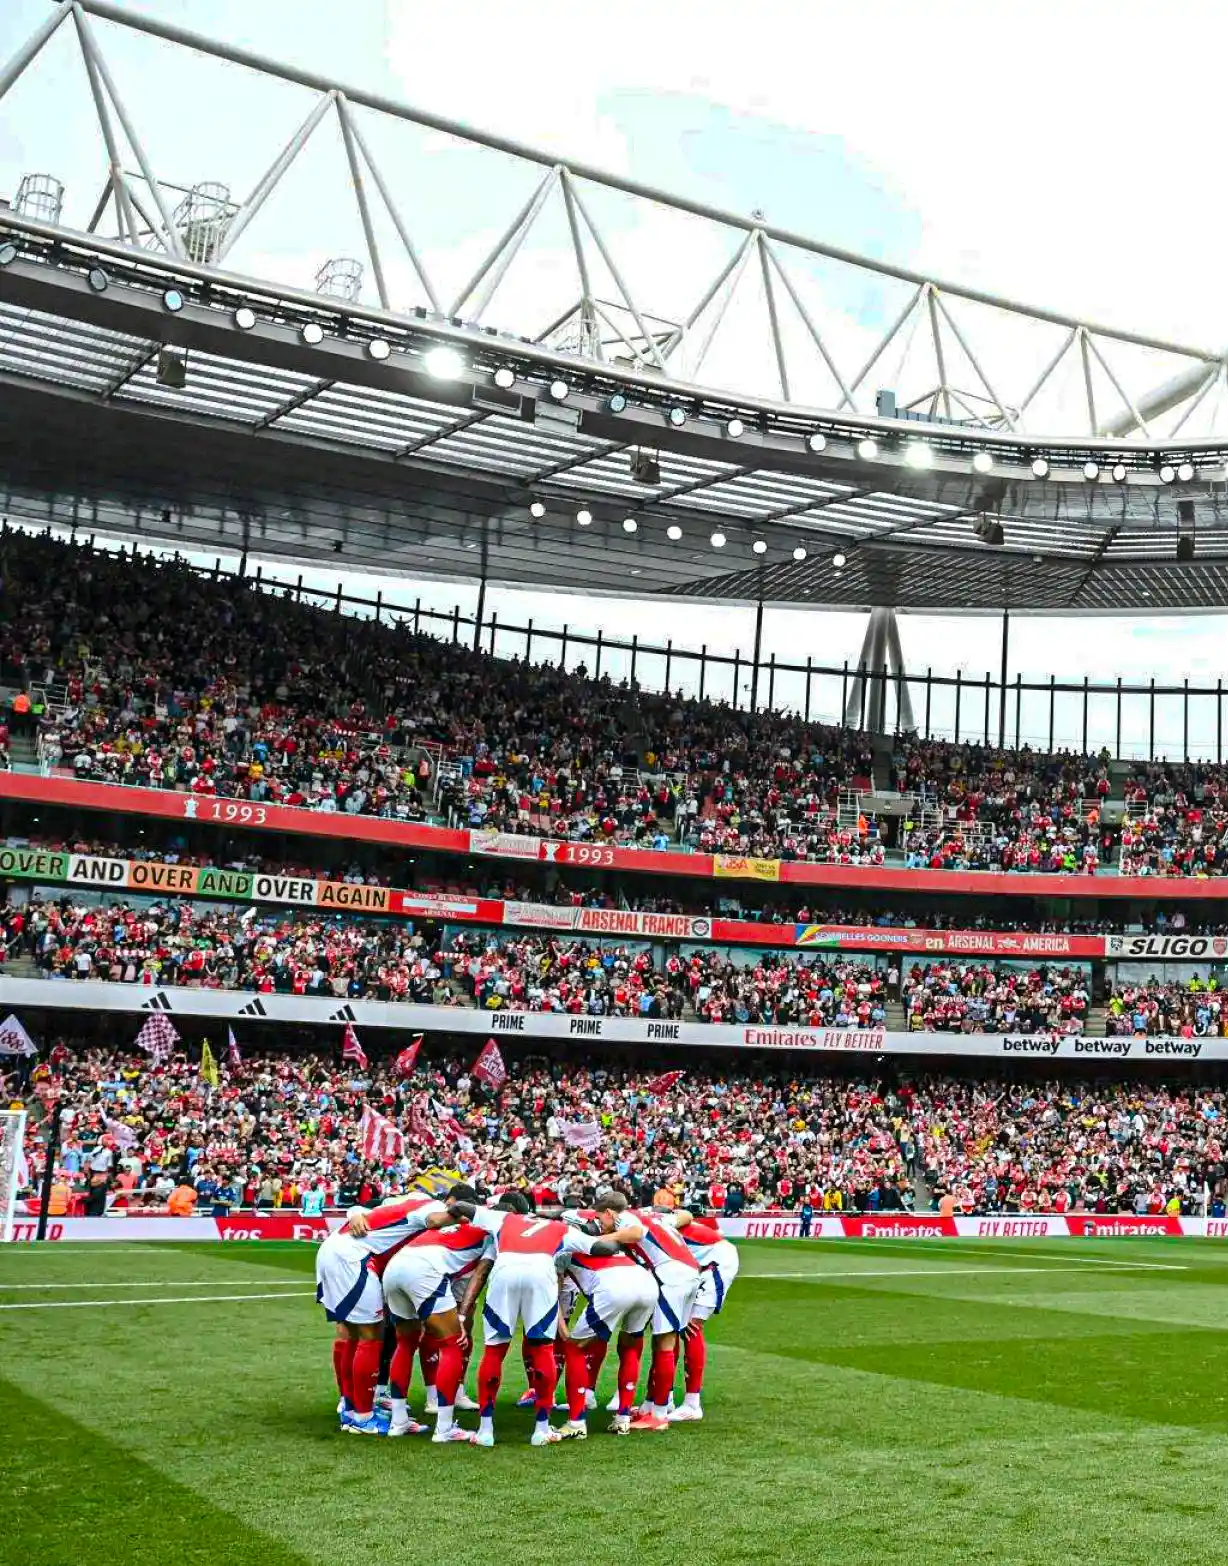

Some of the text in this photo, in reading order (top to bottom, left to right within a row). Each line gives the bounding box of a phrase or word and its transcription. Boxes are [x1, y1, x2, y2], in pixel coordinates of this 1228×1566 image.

[211, 803, 267, 824] 1993
[567, 846, 614, 865] 1993
[0, 851, 386, 910] OVER AND OVER AND OVER AGAIN
[582, 910, 639, 932] ARSENAL
[641, 914, 691, 936] FRANCE
[925, 937, 944, 949] en
[947, 935, 1069, 952] ARSENAL AMERICA
[1128, 938, 1208, 956] SLIGO
[491, 1013, 525, 1031] PRIME
[569, 1019, 602, 1035] PRIME
[647, 1022, 680, 1039] PRIME
[744, 1028, 884, 1049] Emirates FLY BETTER
[1003, 1038, 1060, 1055] betway
[1074, 1039, 1132, 1056] betway
[1145, 1040, 1202, 1057] betway
[519, 1216, 551, 1238] 7
[773, 1223, 824, 1239] BETR
[861, 1222, 943, 1238] Emirates
[1003, 1222, 1049, 1237] BETTER
[1083, 1220, 1168, 1237] Emirates
